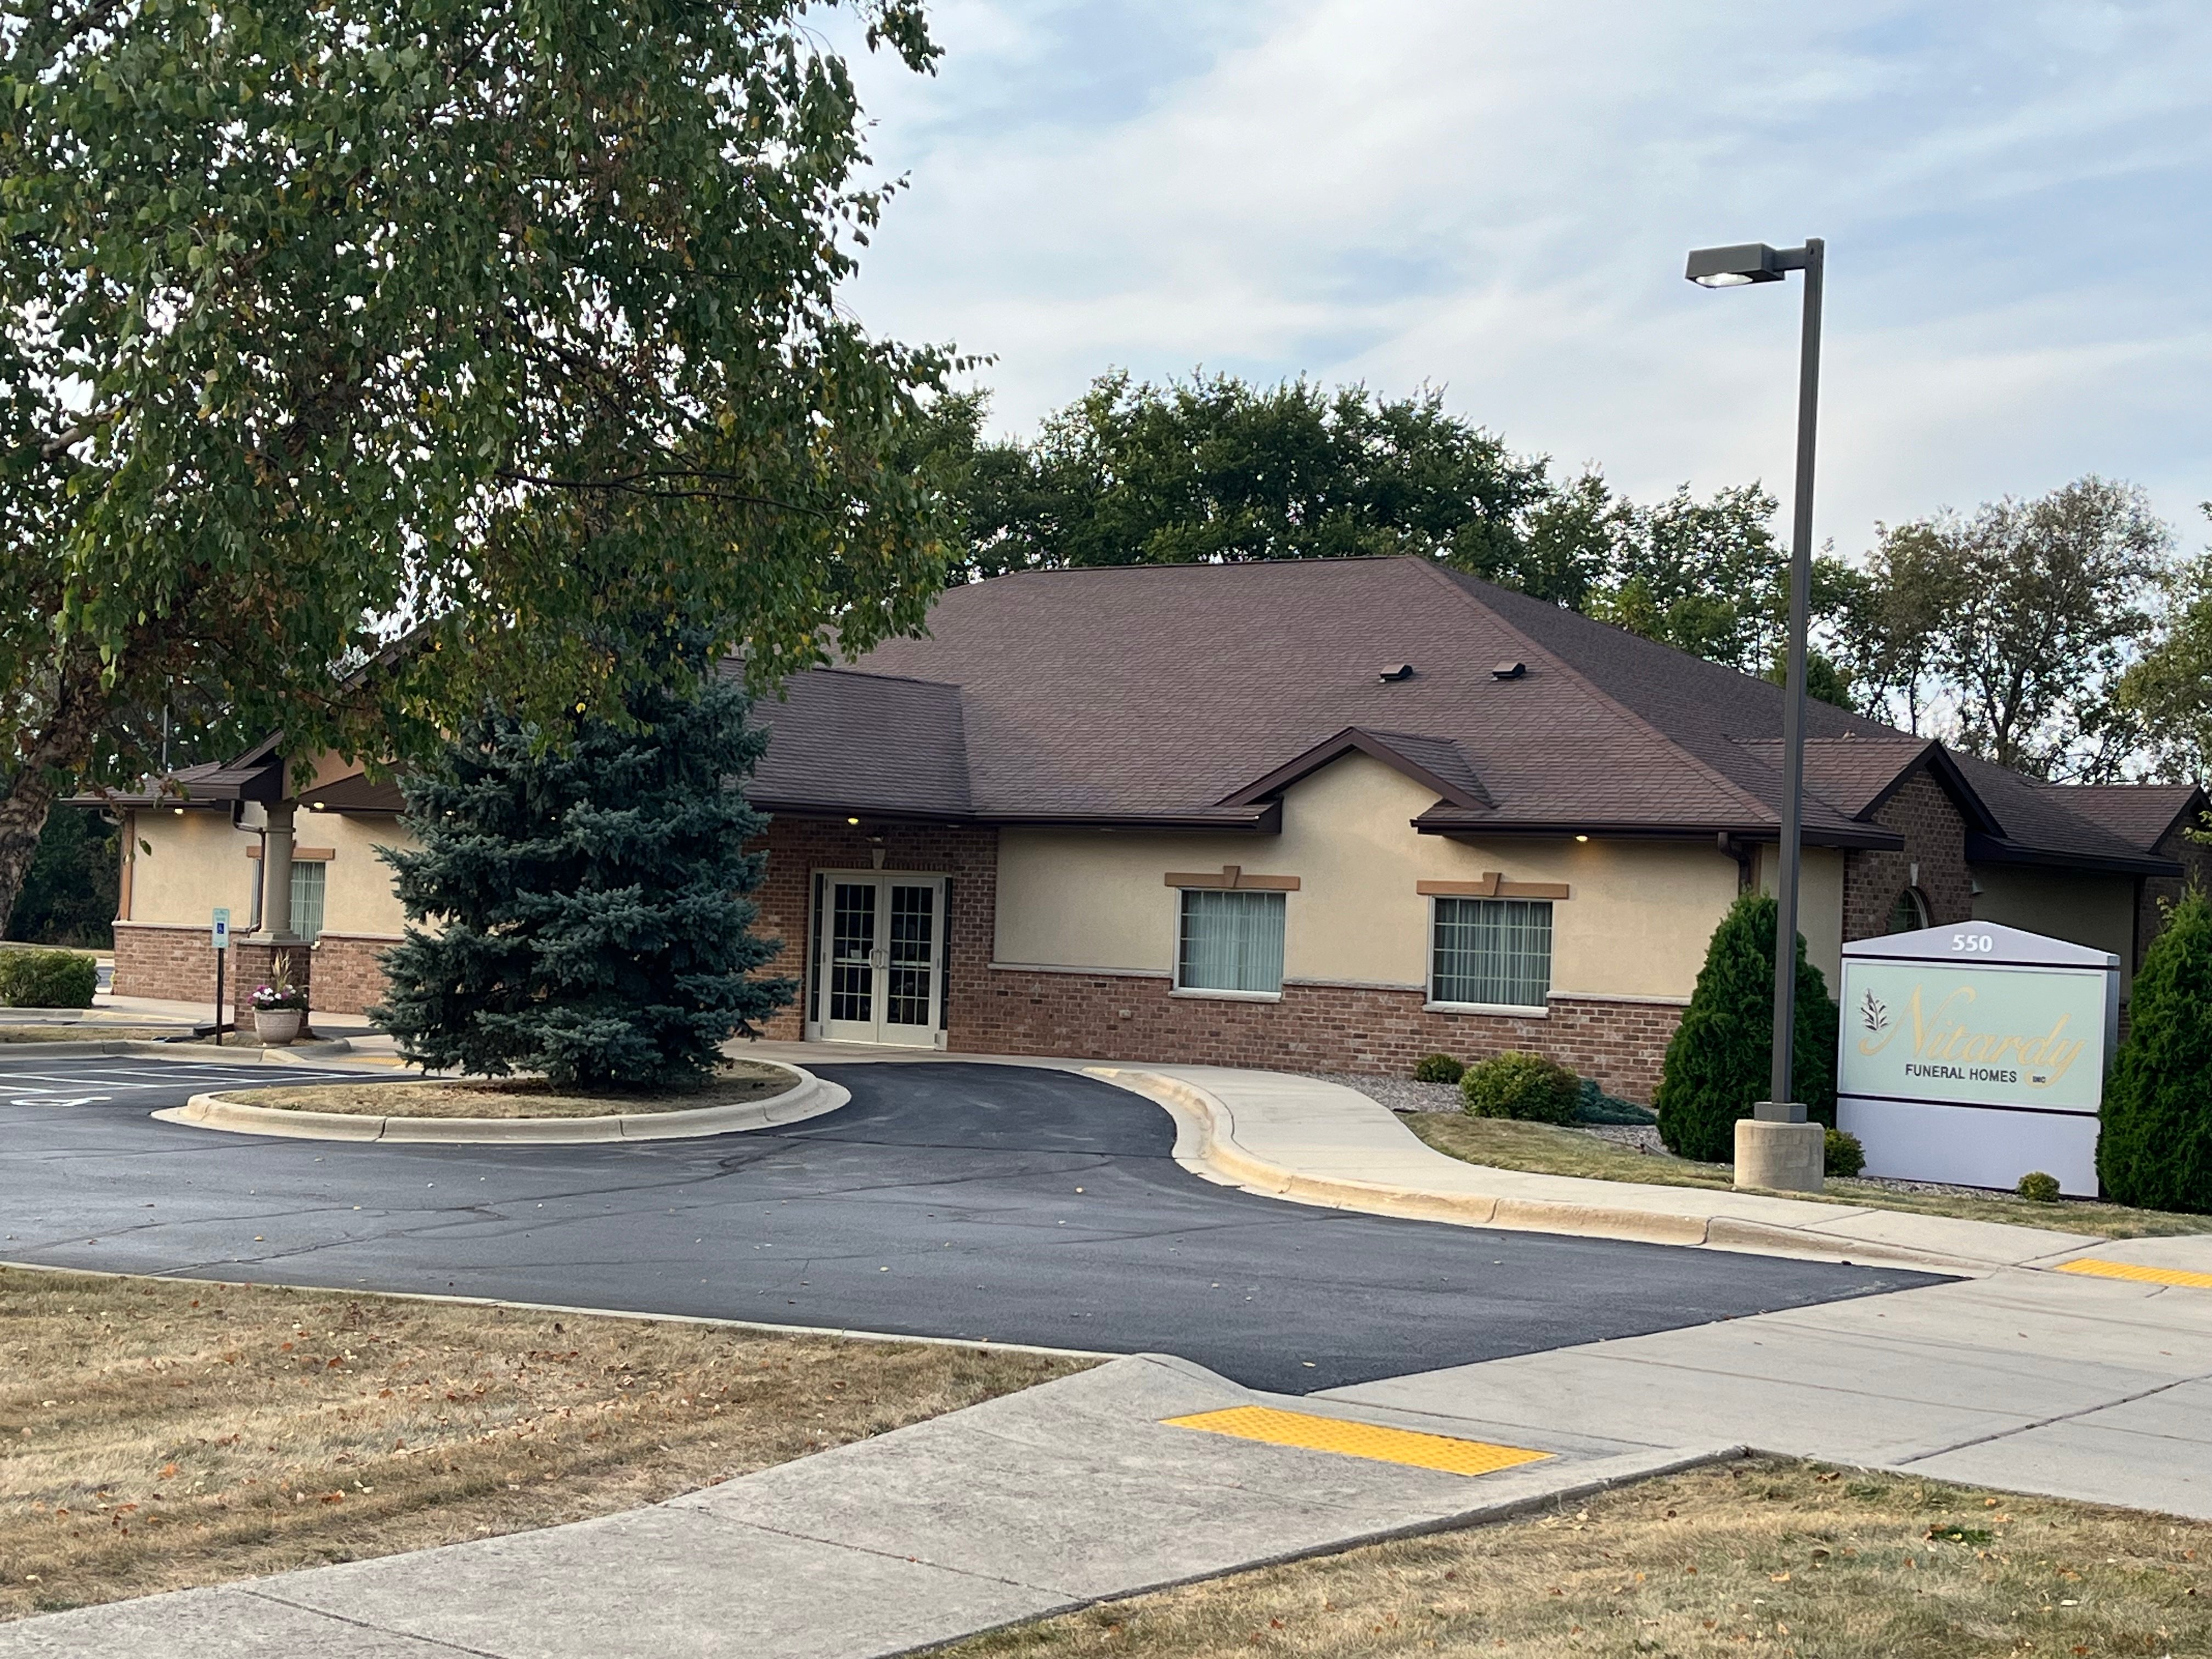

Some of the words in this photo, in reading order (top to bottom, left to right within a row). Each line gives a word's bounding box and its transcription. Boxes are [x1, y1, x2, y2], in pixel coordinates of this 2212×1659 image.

[1951, 934, 1993, 952] 550
[1859, 984, 2083, 1087] Nitardy
[1905, 1064, 1965, 1080] FUNERAL
[1970, 1068, 2017, 1083] HOMES
